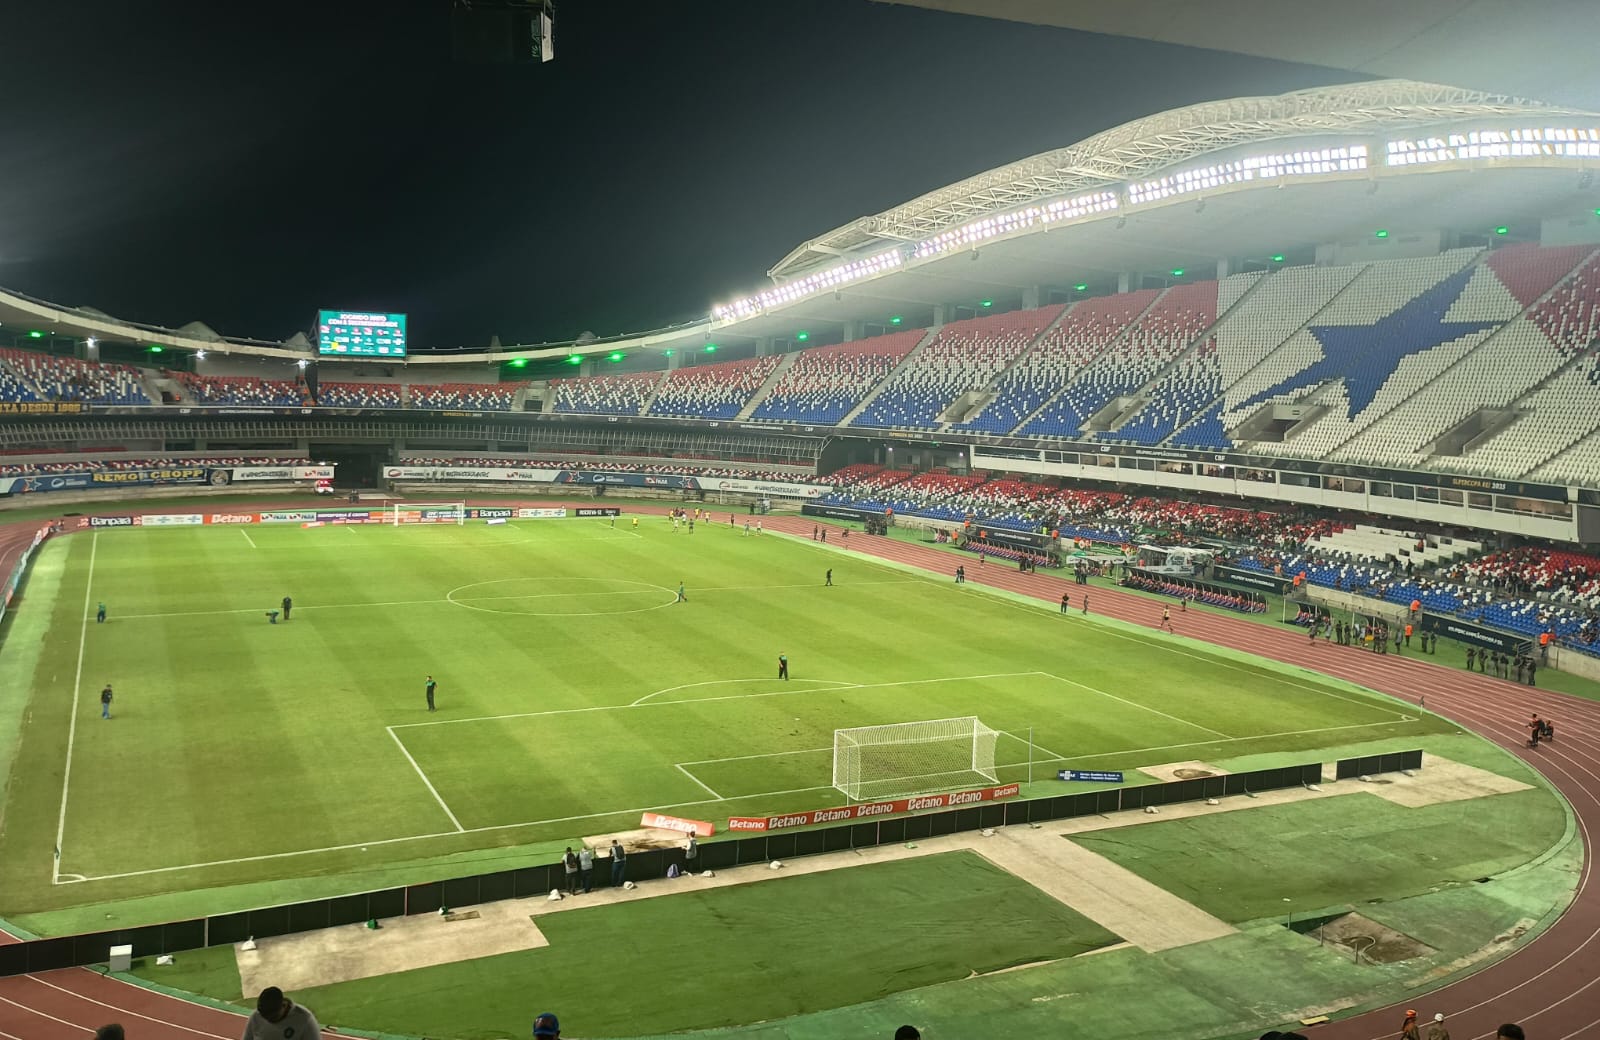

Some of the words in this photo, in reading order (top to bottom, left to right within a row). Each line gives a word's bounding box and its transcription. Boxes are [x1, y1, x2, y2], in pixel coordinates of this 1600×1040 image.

[20, 403, 56, 413] DESDE
[93, 472, 138, 482] REMO
[150, 469, 204, 480] CHOPP
[211, 513, 252, 524] Betano
[948, 791, 982, 805] Betano
[994, 786, 1018, 798] Betano
[857, 803, 893, 817] Betano
[907, 796, 943, 811] Betano
[768, 815, 807, 829] Betano
[813, 809, 851, 823] Betano
[654, 815, 698, 832] Betano
[729, 819, 765, 829] Betano
